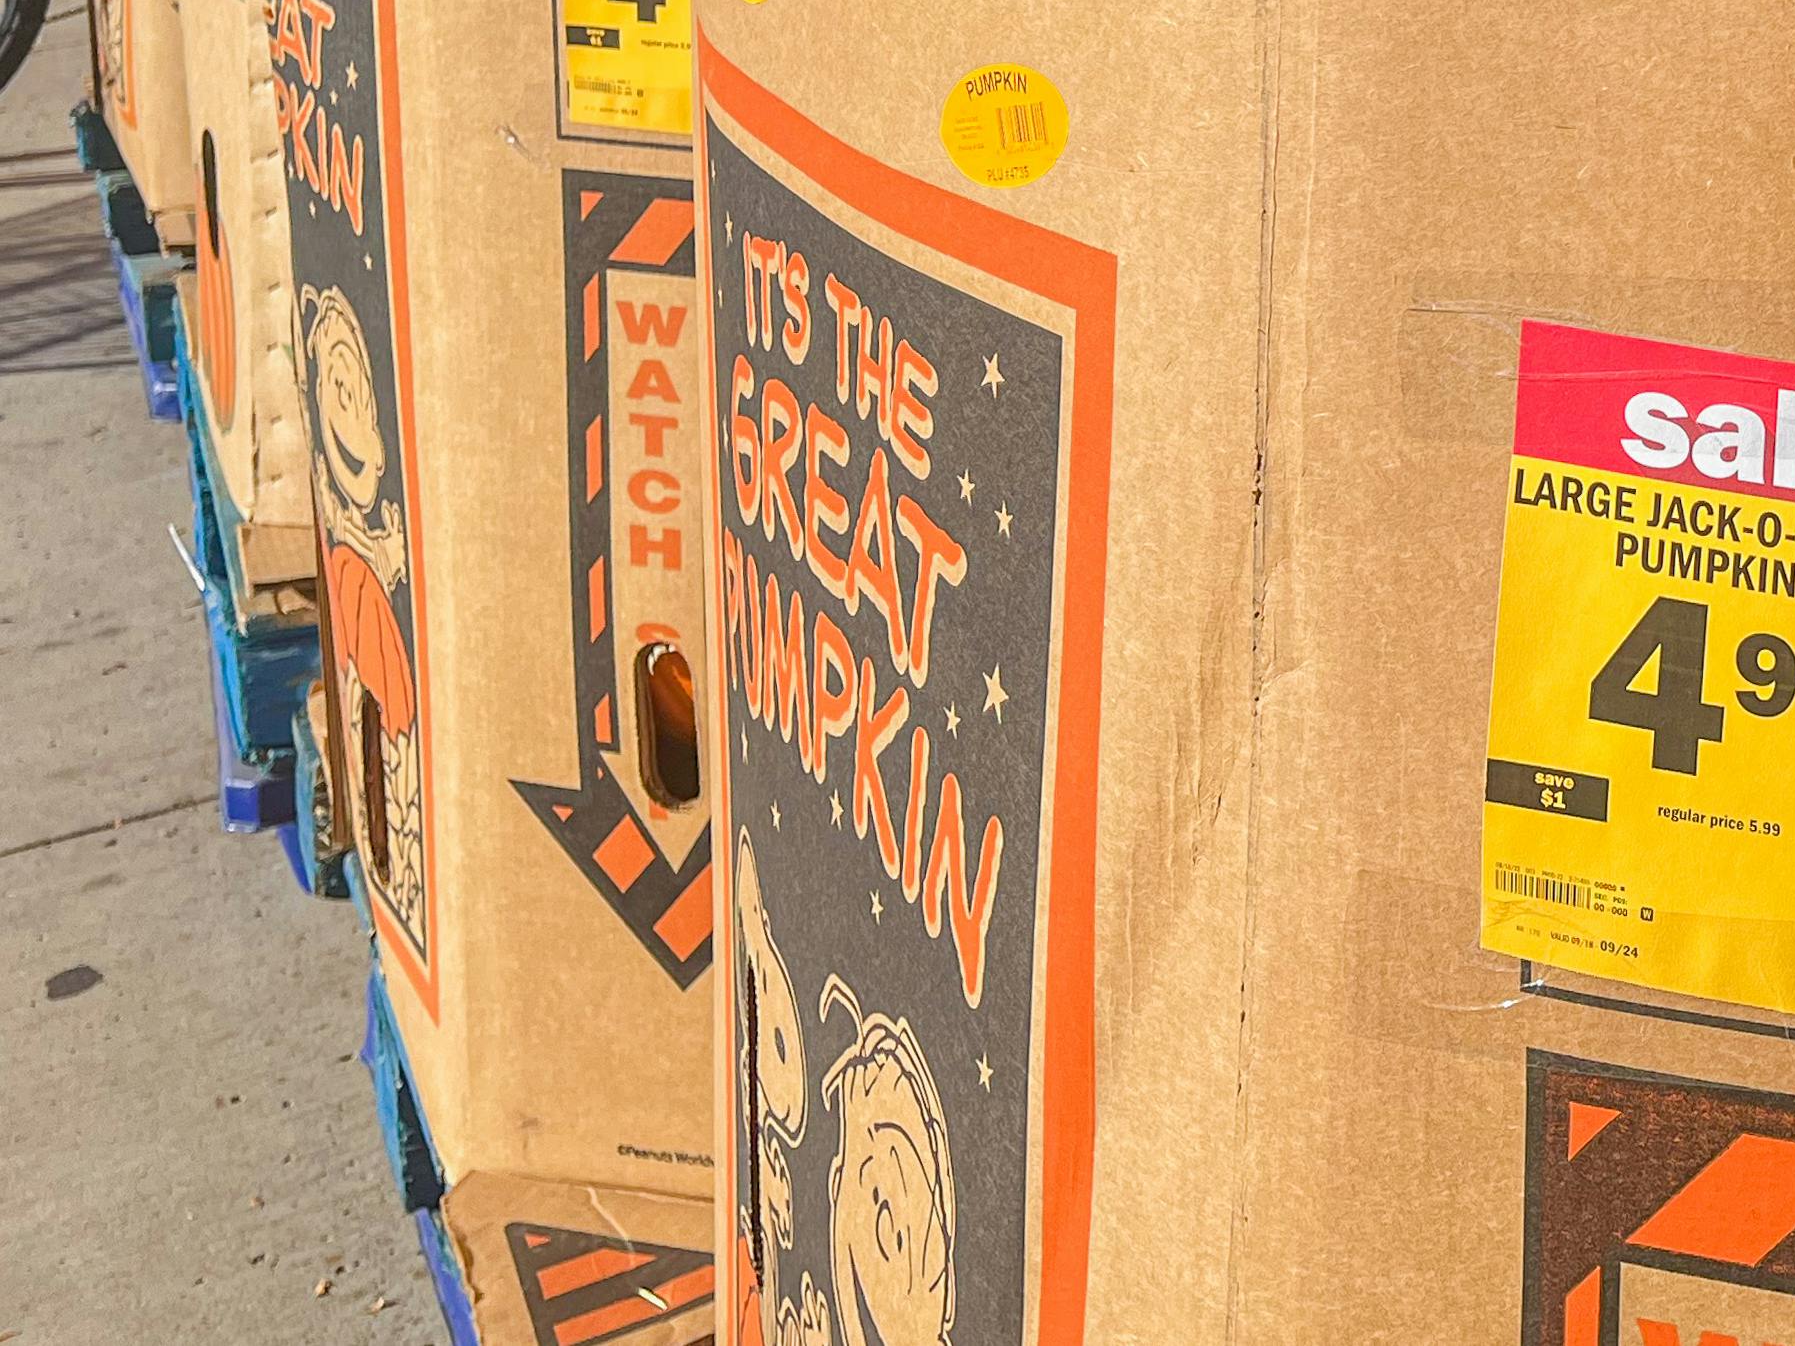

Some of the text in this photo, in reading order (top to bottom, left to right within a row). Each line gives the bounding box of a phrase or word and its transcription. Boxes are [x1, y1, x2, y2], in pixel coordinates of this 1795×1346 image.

[965, 71, 1027, 102] PUMPKIN
[742, 231, 940, 480] IT'S THE
[615, 300, 688, 572] WATCH
[1514, 468, 1636, 524] LARGE
[731, 354, 968, 688] GREAT
[724, 526, 1003, 1009] PUMPKIN
[1534, 771, 1576, 791] save
[1540, 787, 1567, 809] $1
[1657, 805, 1781, 837] regular price 5.99
[1600, 940, 1639, 959] 09/24
